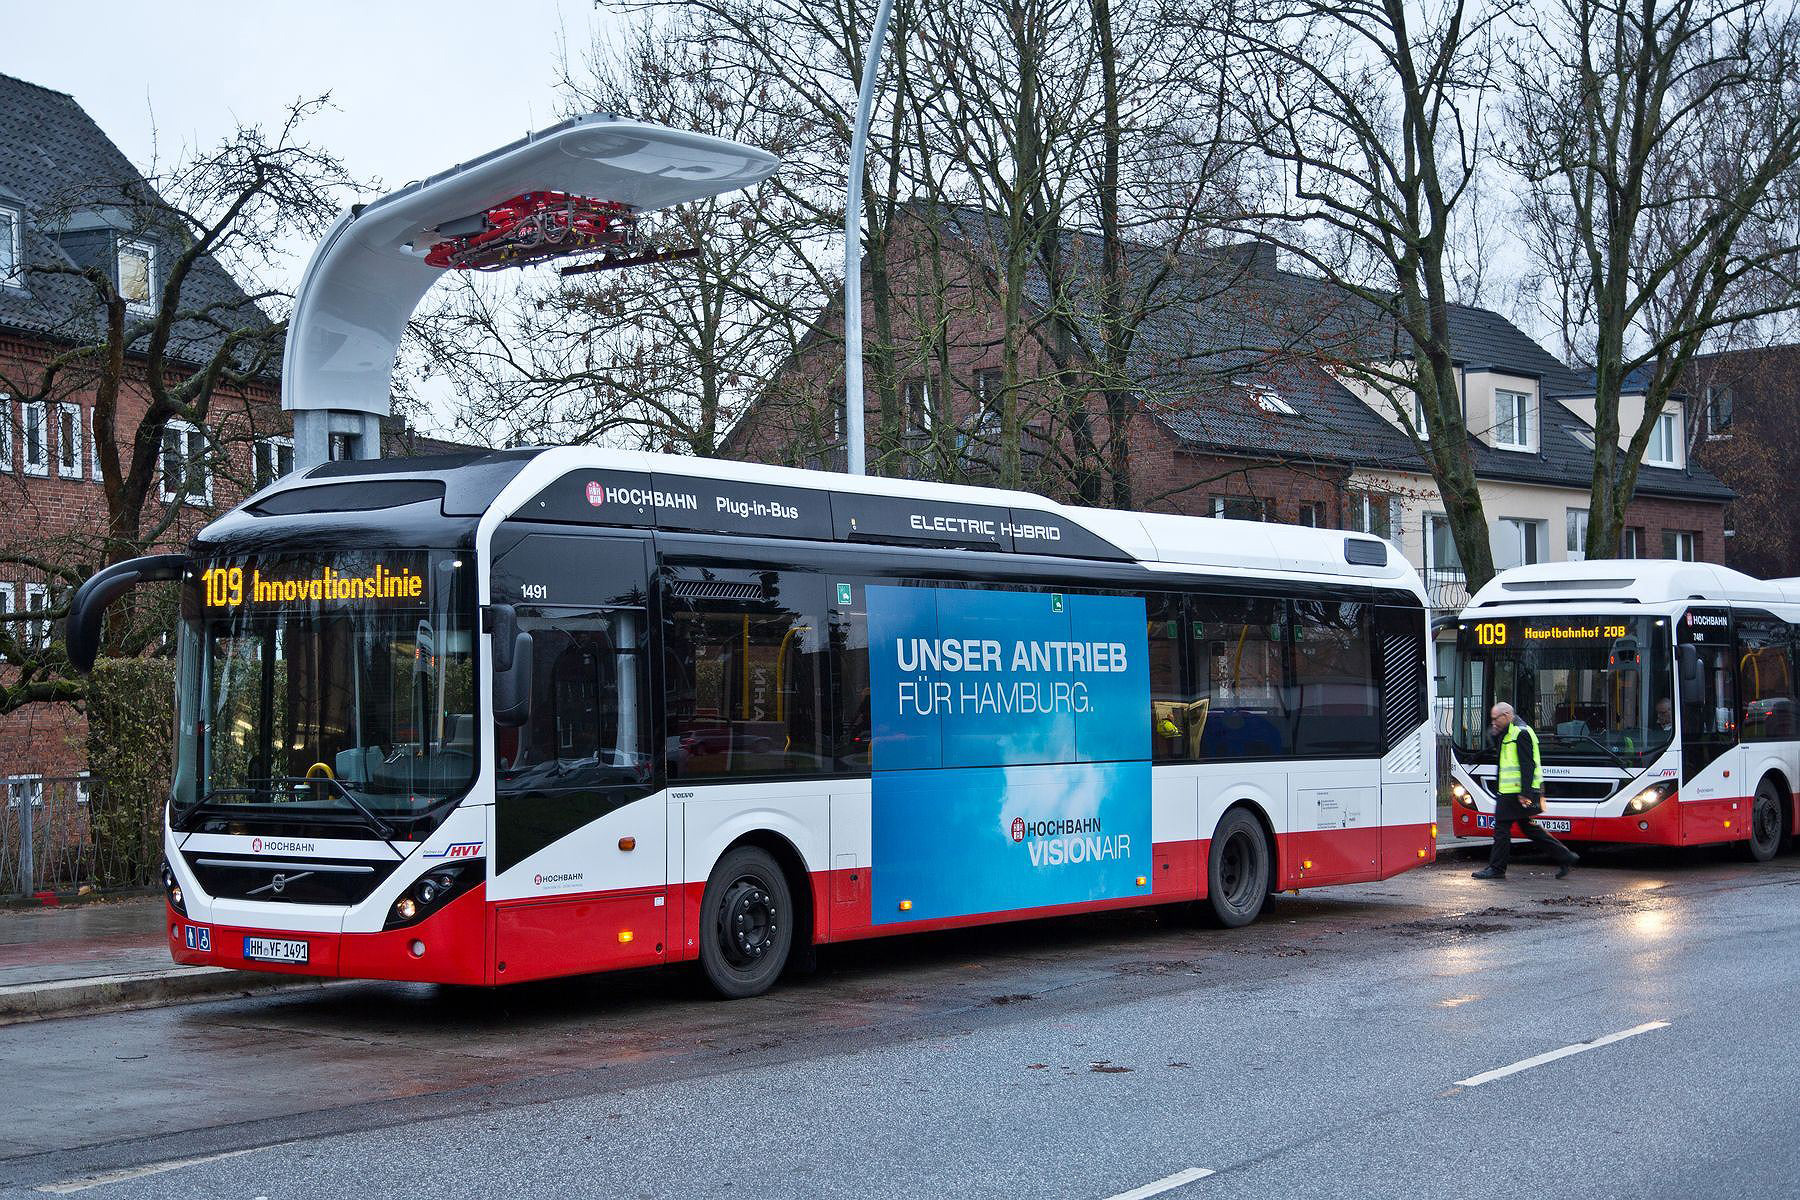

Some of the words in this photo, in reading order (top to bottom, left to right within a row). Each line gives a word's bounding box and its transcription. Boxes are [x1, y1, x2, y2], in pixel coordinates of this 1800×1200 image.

[605, 487, 698, 510] HOCHBAHN
[716, 496, 799, 520] Plug-in-Bus
[910, 514, 995, 535] ELECTRIC
[1000, 522, 1061, 541] HYBRID
[201, 567, 243, 607] 109
[253, 564, 423, 602] Innovationslinie
[520, 583, 548, 599] 1491
[1693, 615, 1728, 627] HOCHBAHN
[1474, 623, 1506, 645] 109
[1524, 626, 1600, 641] Hauptbahnhof
[896, 638, 1002, 672] UNSER
[1011, 640, 1128, 672] ANTRIEB
[898, 676, 952, 715] FÜR
[960, 682, 1095, 714] HAMBURG.
[671, 791, 694, 799] VOLVO
[1027, 817, 1101, 837] HOCHBAHN
[264, 840, 316, 853] HOCHBAHN
[449, 845, 482, 857] HVV
[1027, 833, 1131, 867] VISIONAIR
[542, 872, 584, 883] HOCHBAHN
[250, 940, 263, 956] HH
[269, 941, 282, 957] YF
[283, 942, 308, 959] 1491
